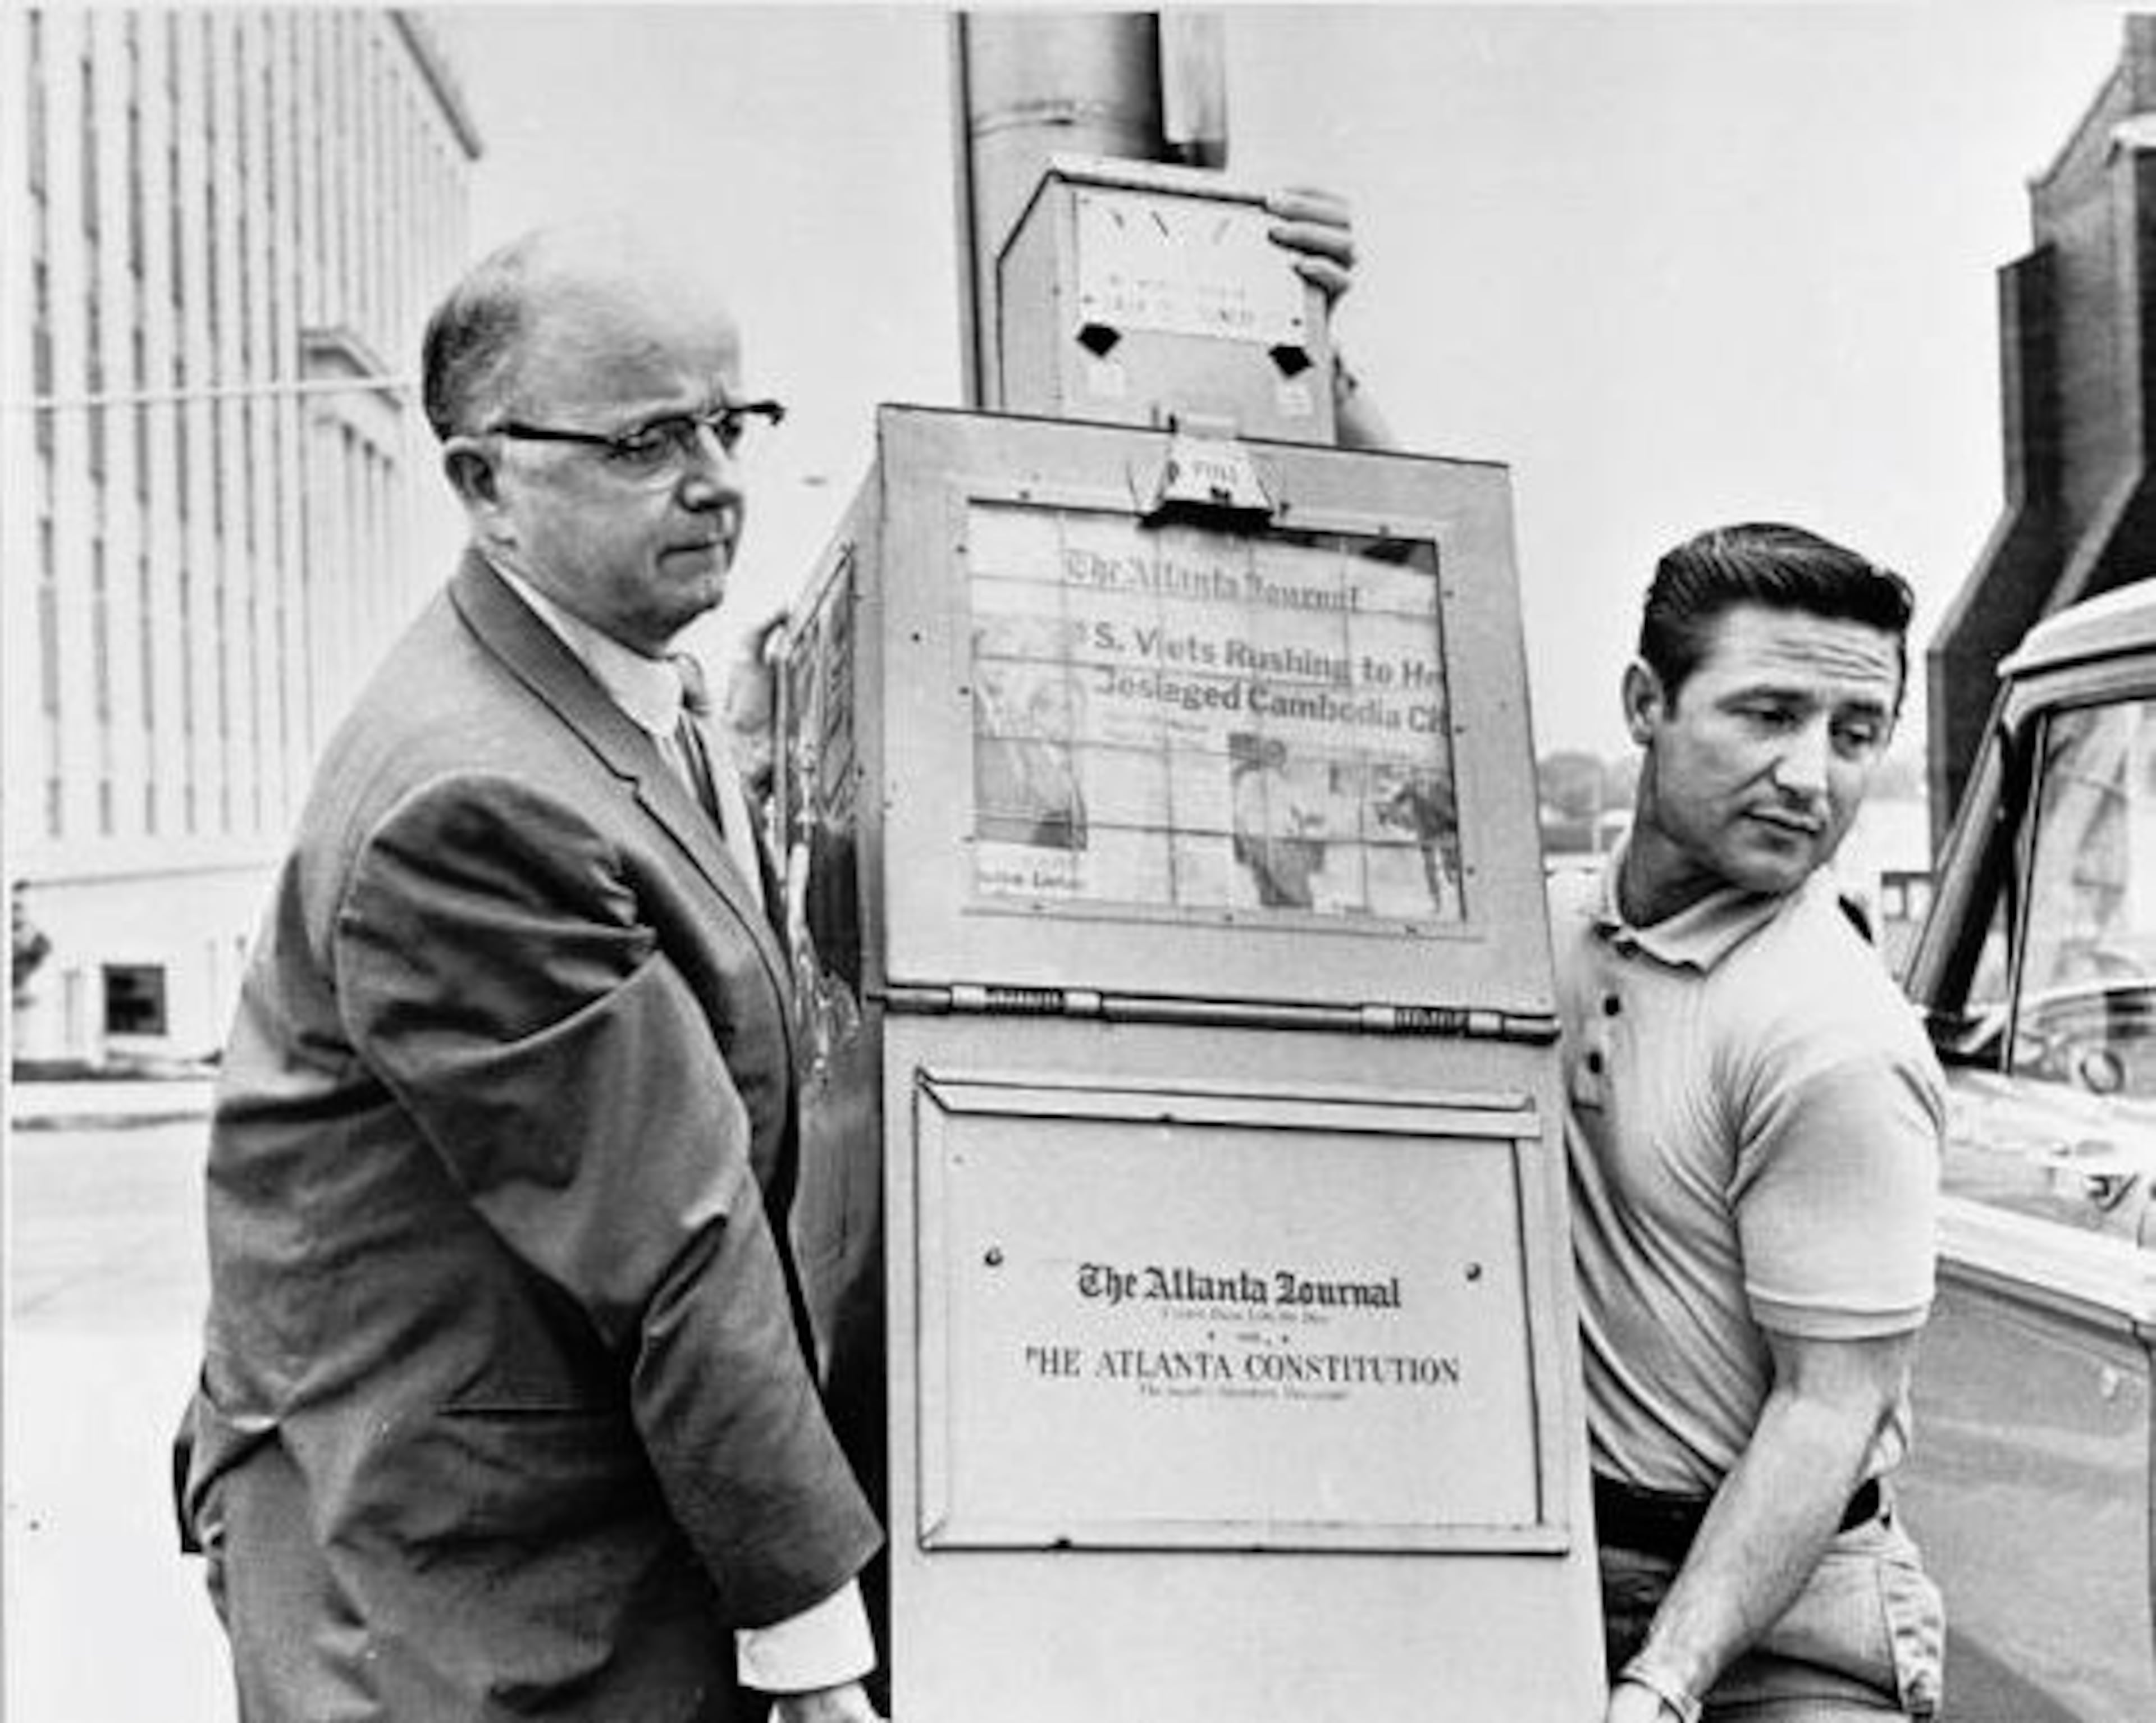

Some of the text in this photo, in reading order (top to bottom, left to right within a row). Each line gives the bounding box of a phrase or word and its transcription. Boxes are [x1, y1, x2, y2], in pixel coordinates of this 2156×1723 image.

[1225, 639, 1349, 685] Rushing
[1362, 656, 1391, 683] to
[1248, 683, 1401, 725] Cambodia
[1079, 1263, 1400, 1308] The Atlanta Journal
[1094, 1348, 1234, 1380] ATLANTA
[1245, 1354, 1459, 1384] CONSTITUTION
